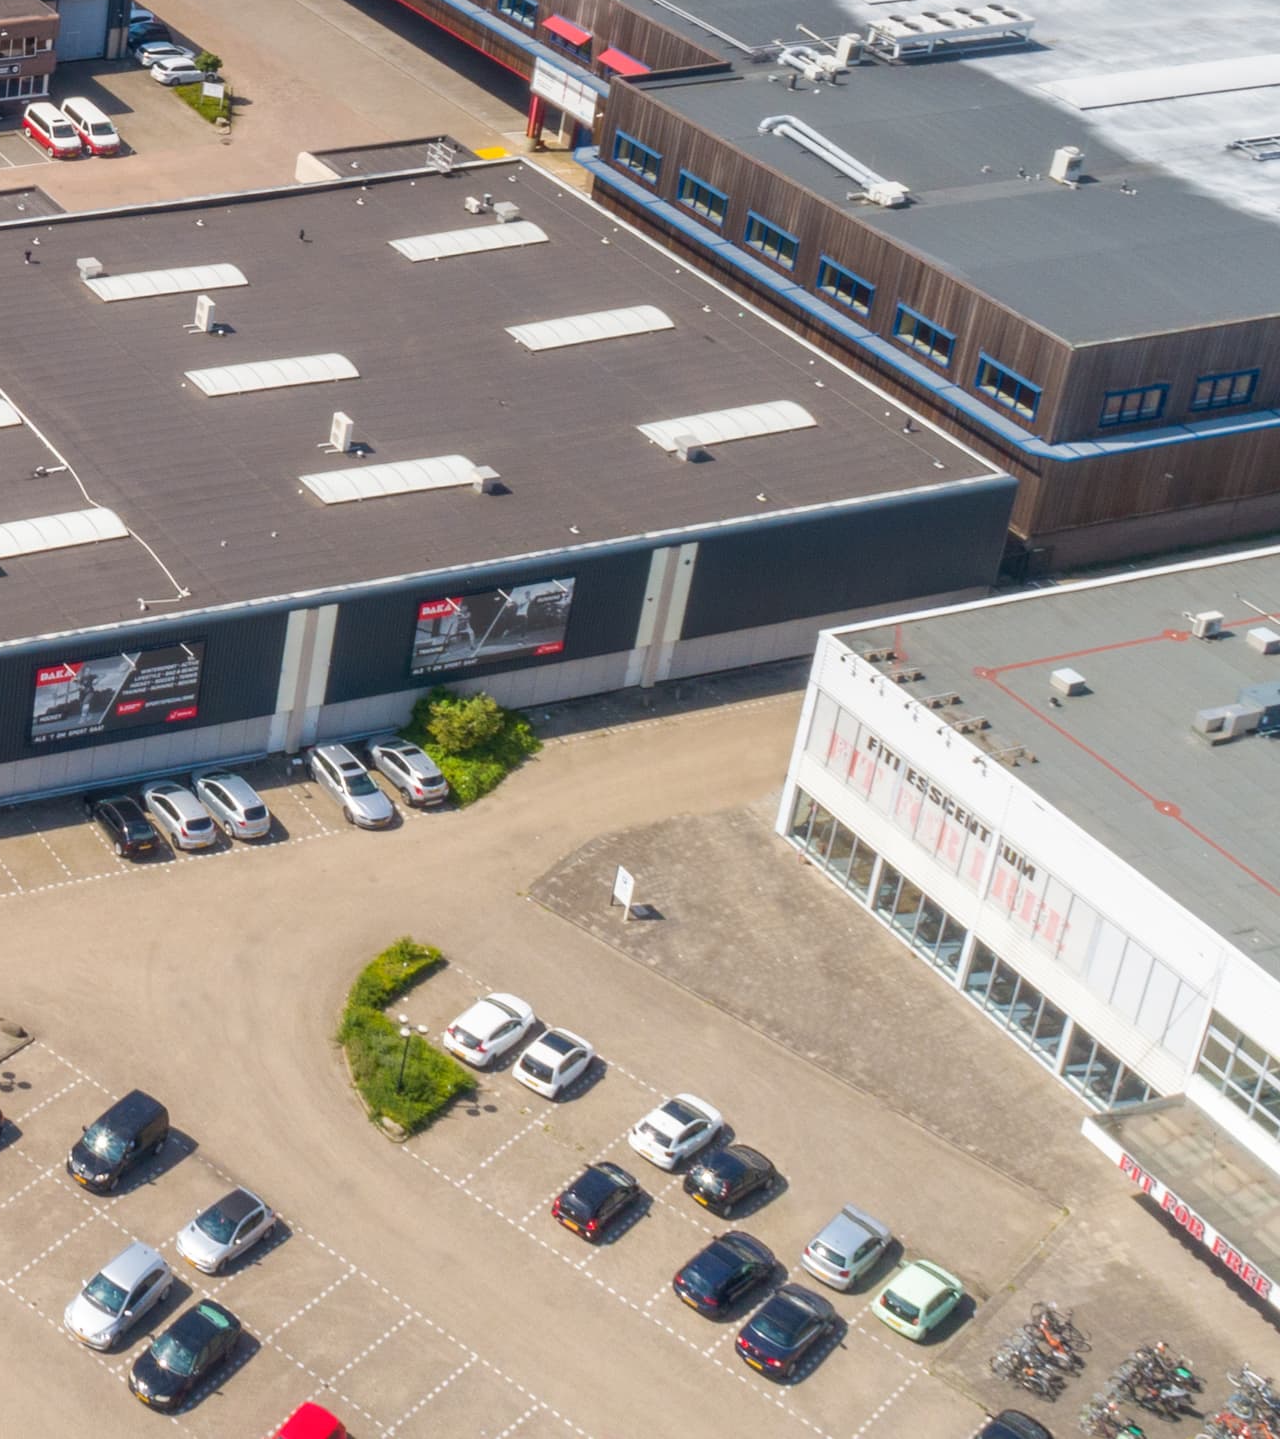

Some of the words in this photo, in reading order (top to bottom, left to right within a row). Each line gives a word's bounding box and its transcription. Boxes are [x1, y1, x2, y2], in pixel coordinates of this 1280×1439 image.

[1119, 1152, 1157, 1195] FIT
[1160, 1191, 1206, 1242] FOR
[1211, 1236, 1273, 1300] FREE
